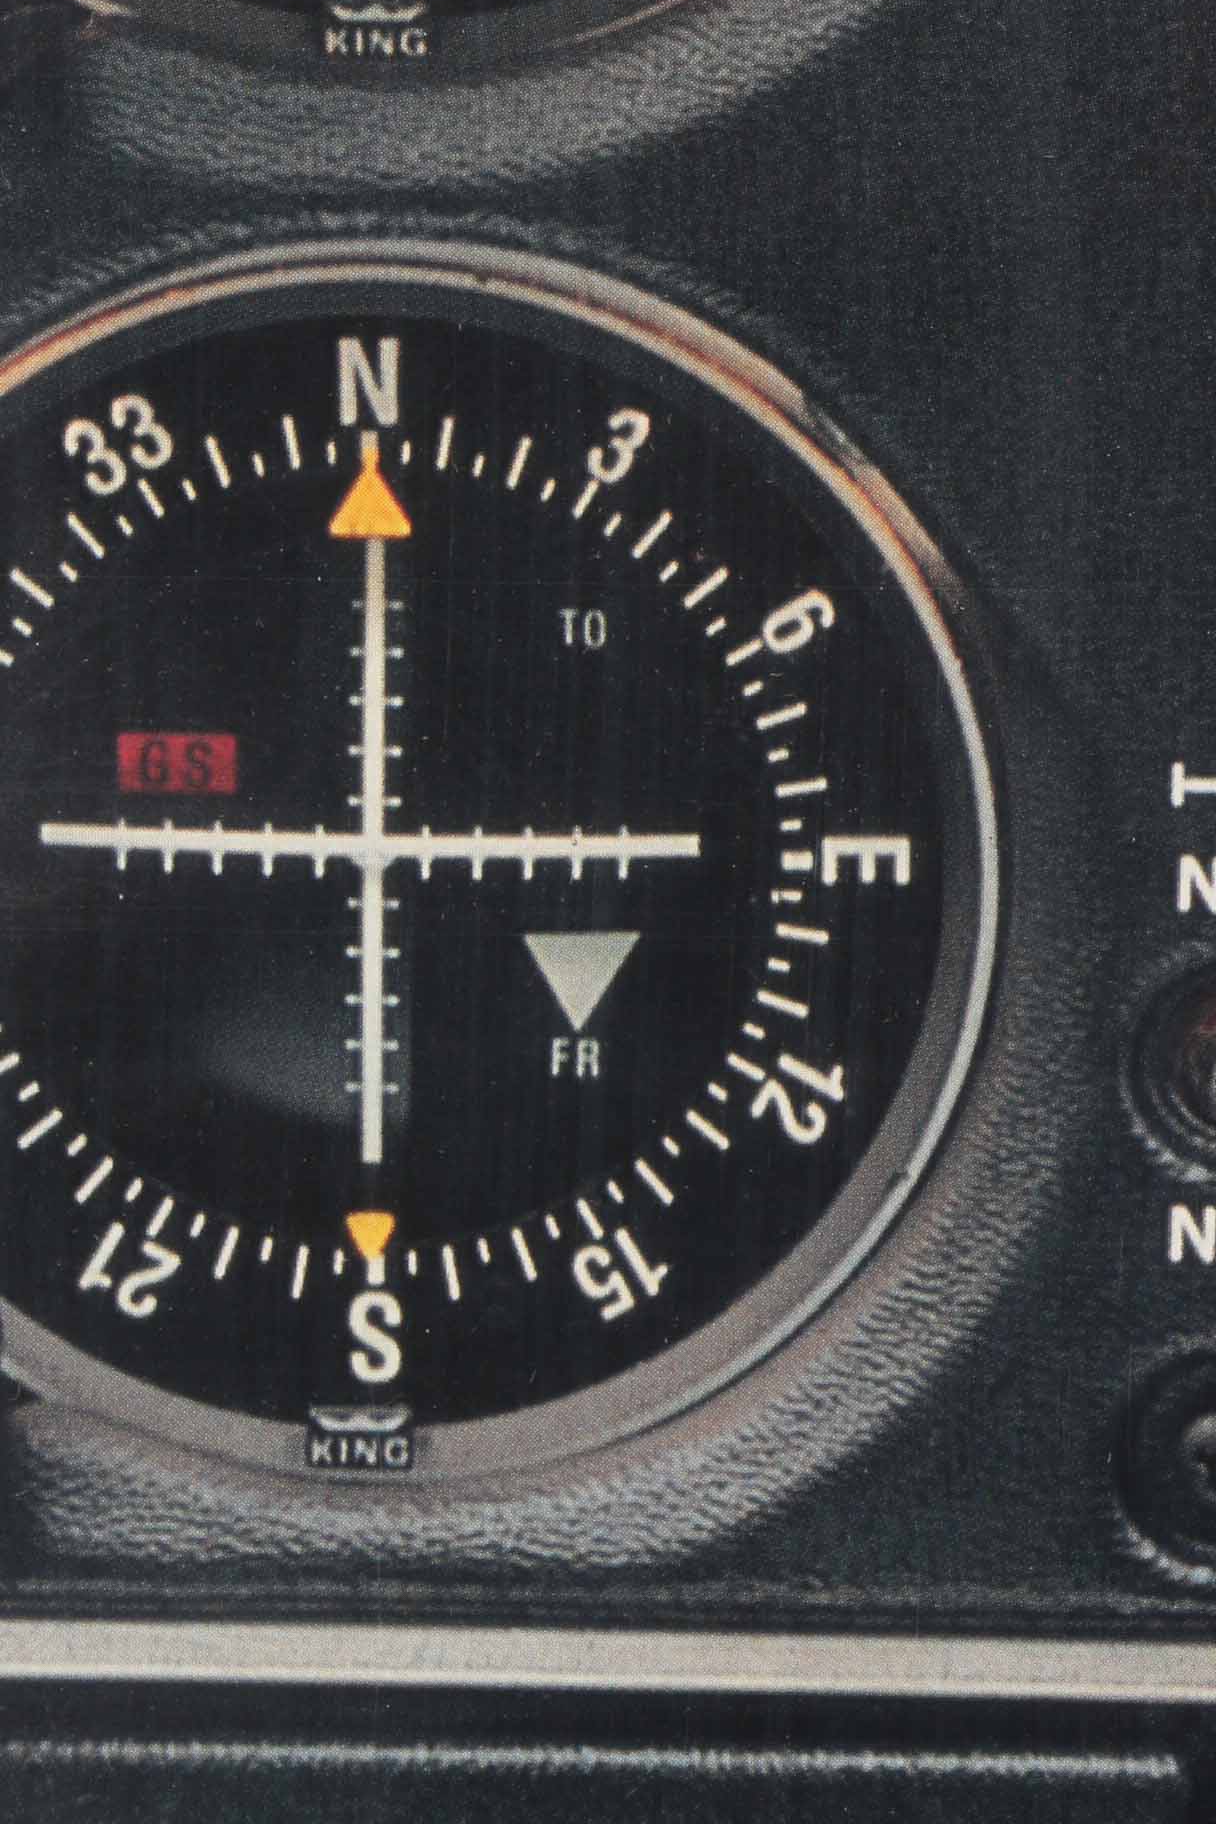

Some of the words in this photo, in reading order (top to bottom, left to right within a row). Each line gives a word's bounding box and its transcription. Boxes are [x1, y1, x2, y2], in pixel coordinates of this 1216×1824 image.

[325, 24, 427, 56] KING
[338, 337, 400, 429] N
[63, 394, 174, 495] 33
[588, 408, 651, 484] 3
[560, 608, 607, 648] TO
[761, 588, 836, 654] 6
[139, 742, 217, 786] GS
[821, 835, 911, 886] E
[550, 1037, 600, 1078] FR
[750, 1053, 846, 1145] 12
[78, 1222, 182, 1318] 21
[572, 1226, 669, 1321] 15
[348, 1290, 403, 1383] S
[311, 1438, 409, 1466] KING
